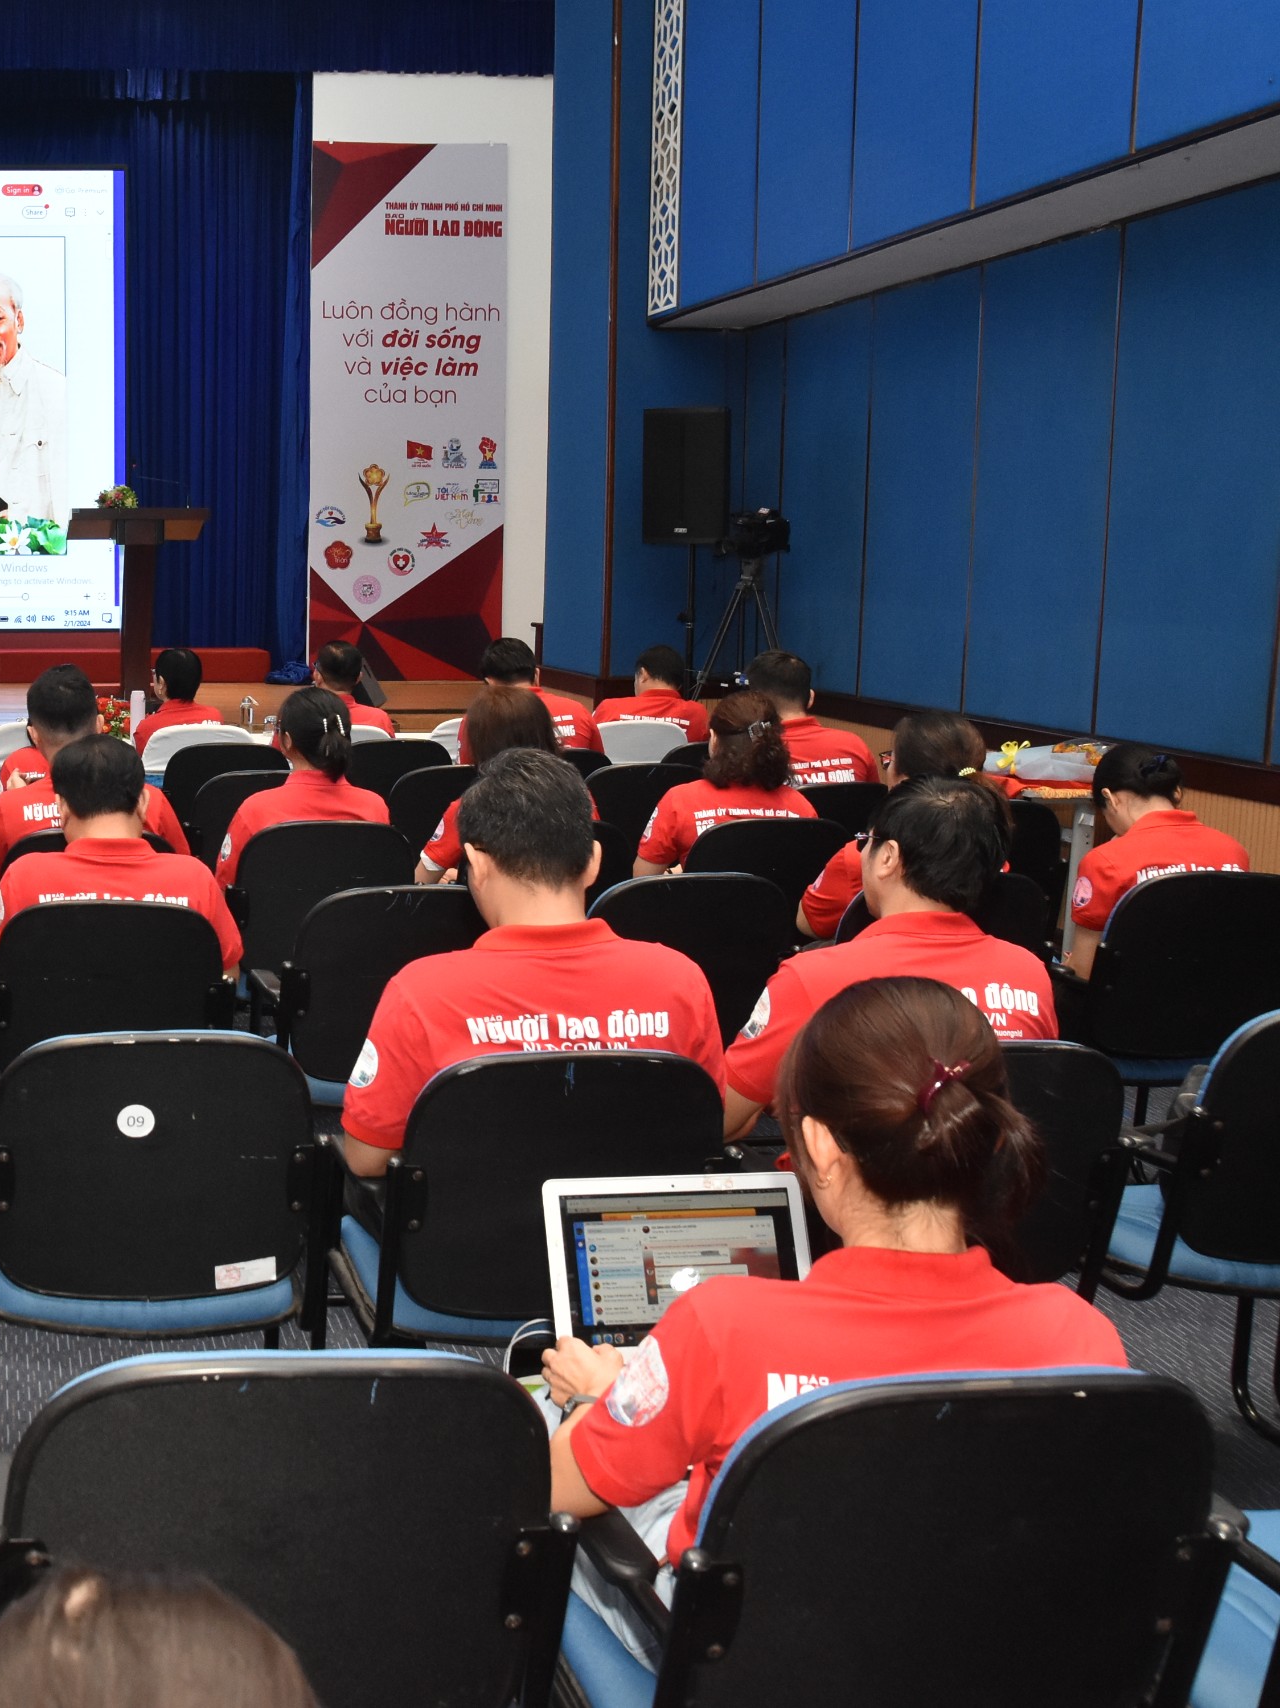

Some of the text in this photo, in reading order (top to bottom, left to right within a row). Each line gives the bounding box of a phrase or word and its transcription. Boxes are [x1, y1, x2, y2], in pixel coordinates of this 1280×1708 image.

[7, 187, 21, 195] Sign
[385, 217, 502, 238] NGƯỜI LAO ĐỘNG
[323, 299, 500, 325] Luôn đồng hành
[343, 326, 481, 354] với đời sống
[345, 356, 478, 380] và việc làm
[365, 383, 456, 408] của bạn
[1, 563, 48, 572] Windows
[985, 983, 1039, 1017] động
[466, 1009, 668, 1045] Người lao động
[126, 1115, 145, 1128] 09
